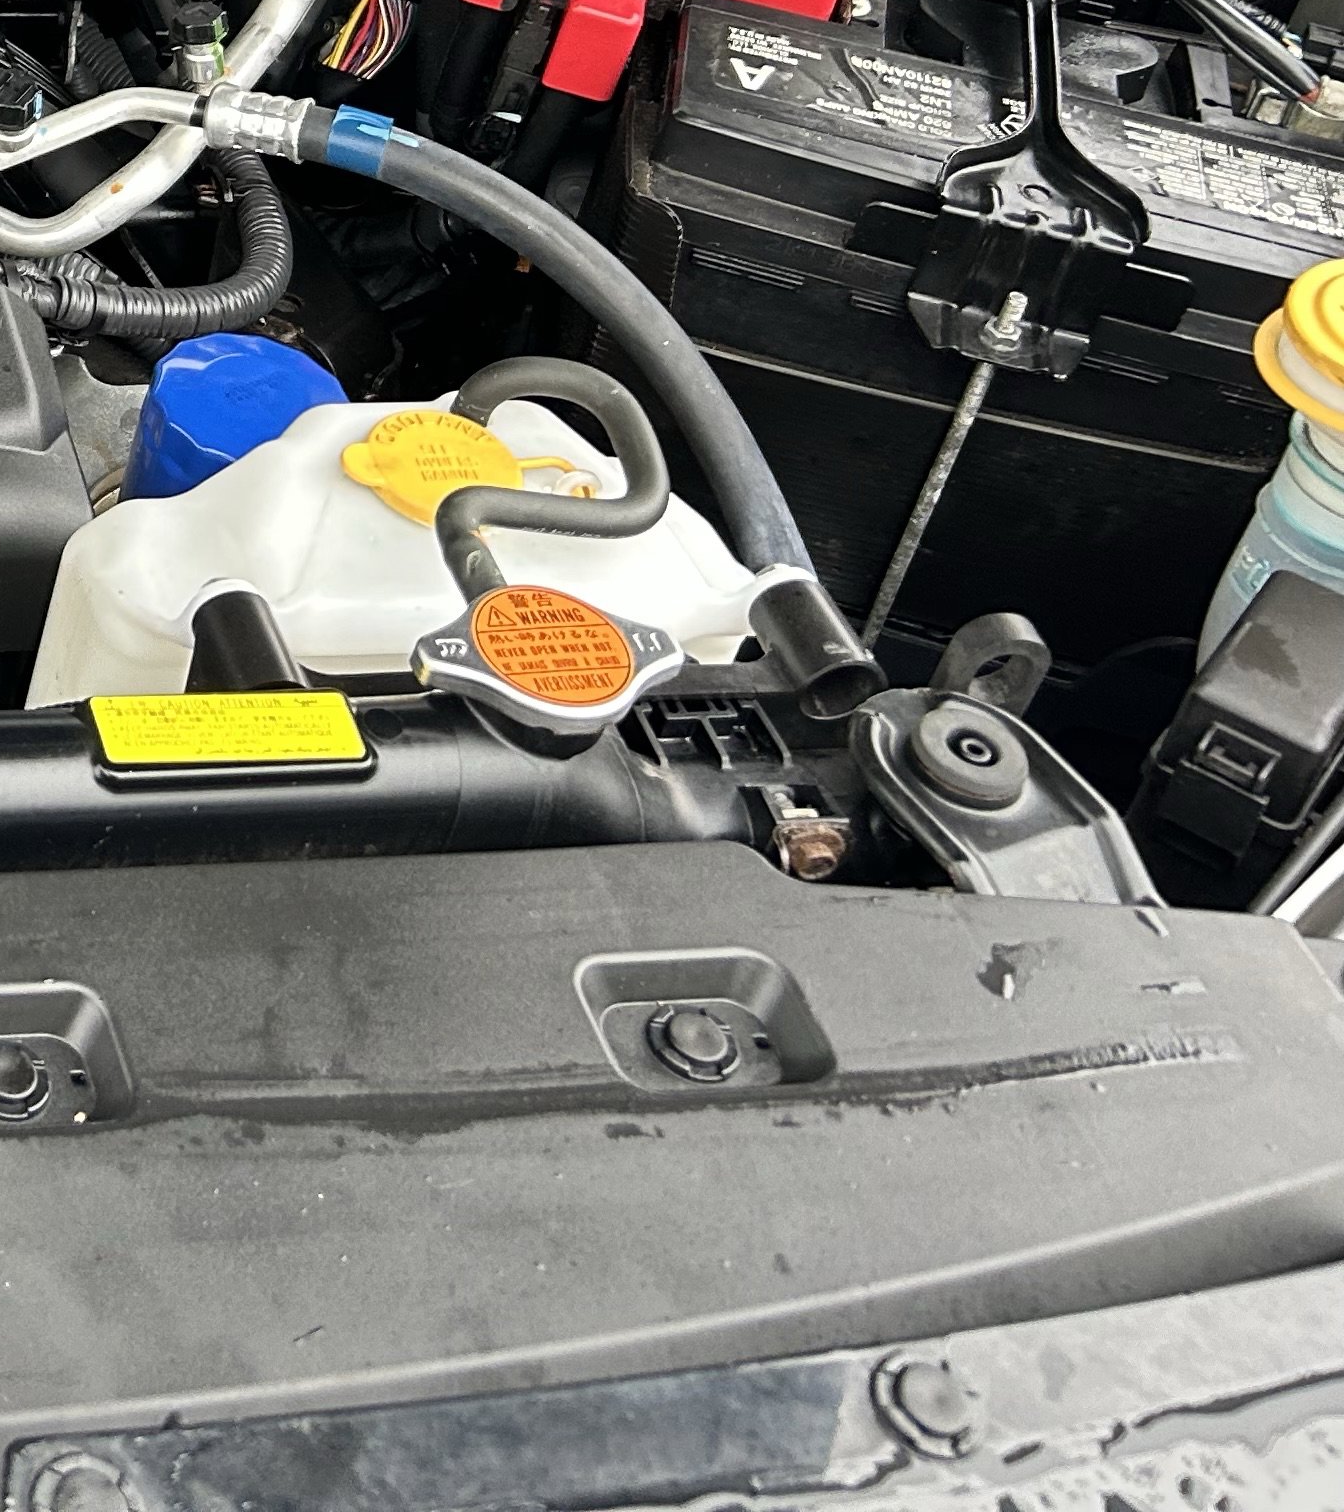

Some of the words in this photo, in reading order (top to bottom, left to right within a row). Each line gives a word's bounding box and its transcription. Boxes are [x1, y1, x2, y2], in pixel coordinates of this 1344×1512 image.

[918, 93, 952, 109] LN2
[514, 607, 586, 625] WARNING
[493, 646, 527, 659] NEVER
[531, 644, 557, 656] OPEN
